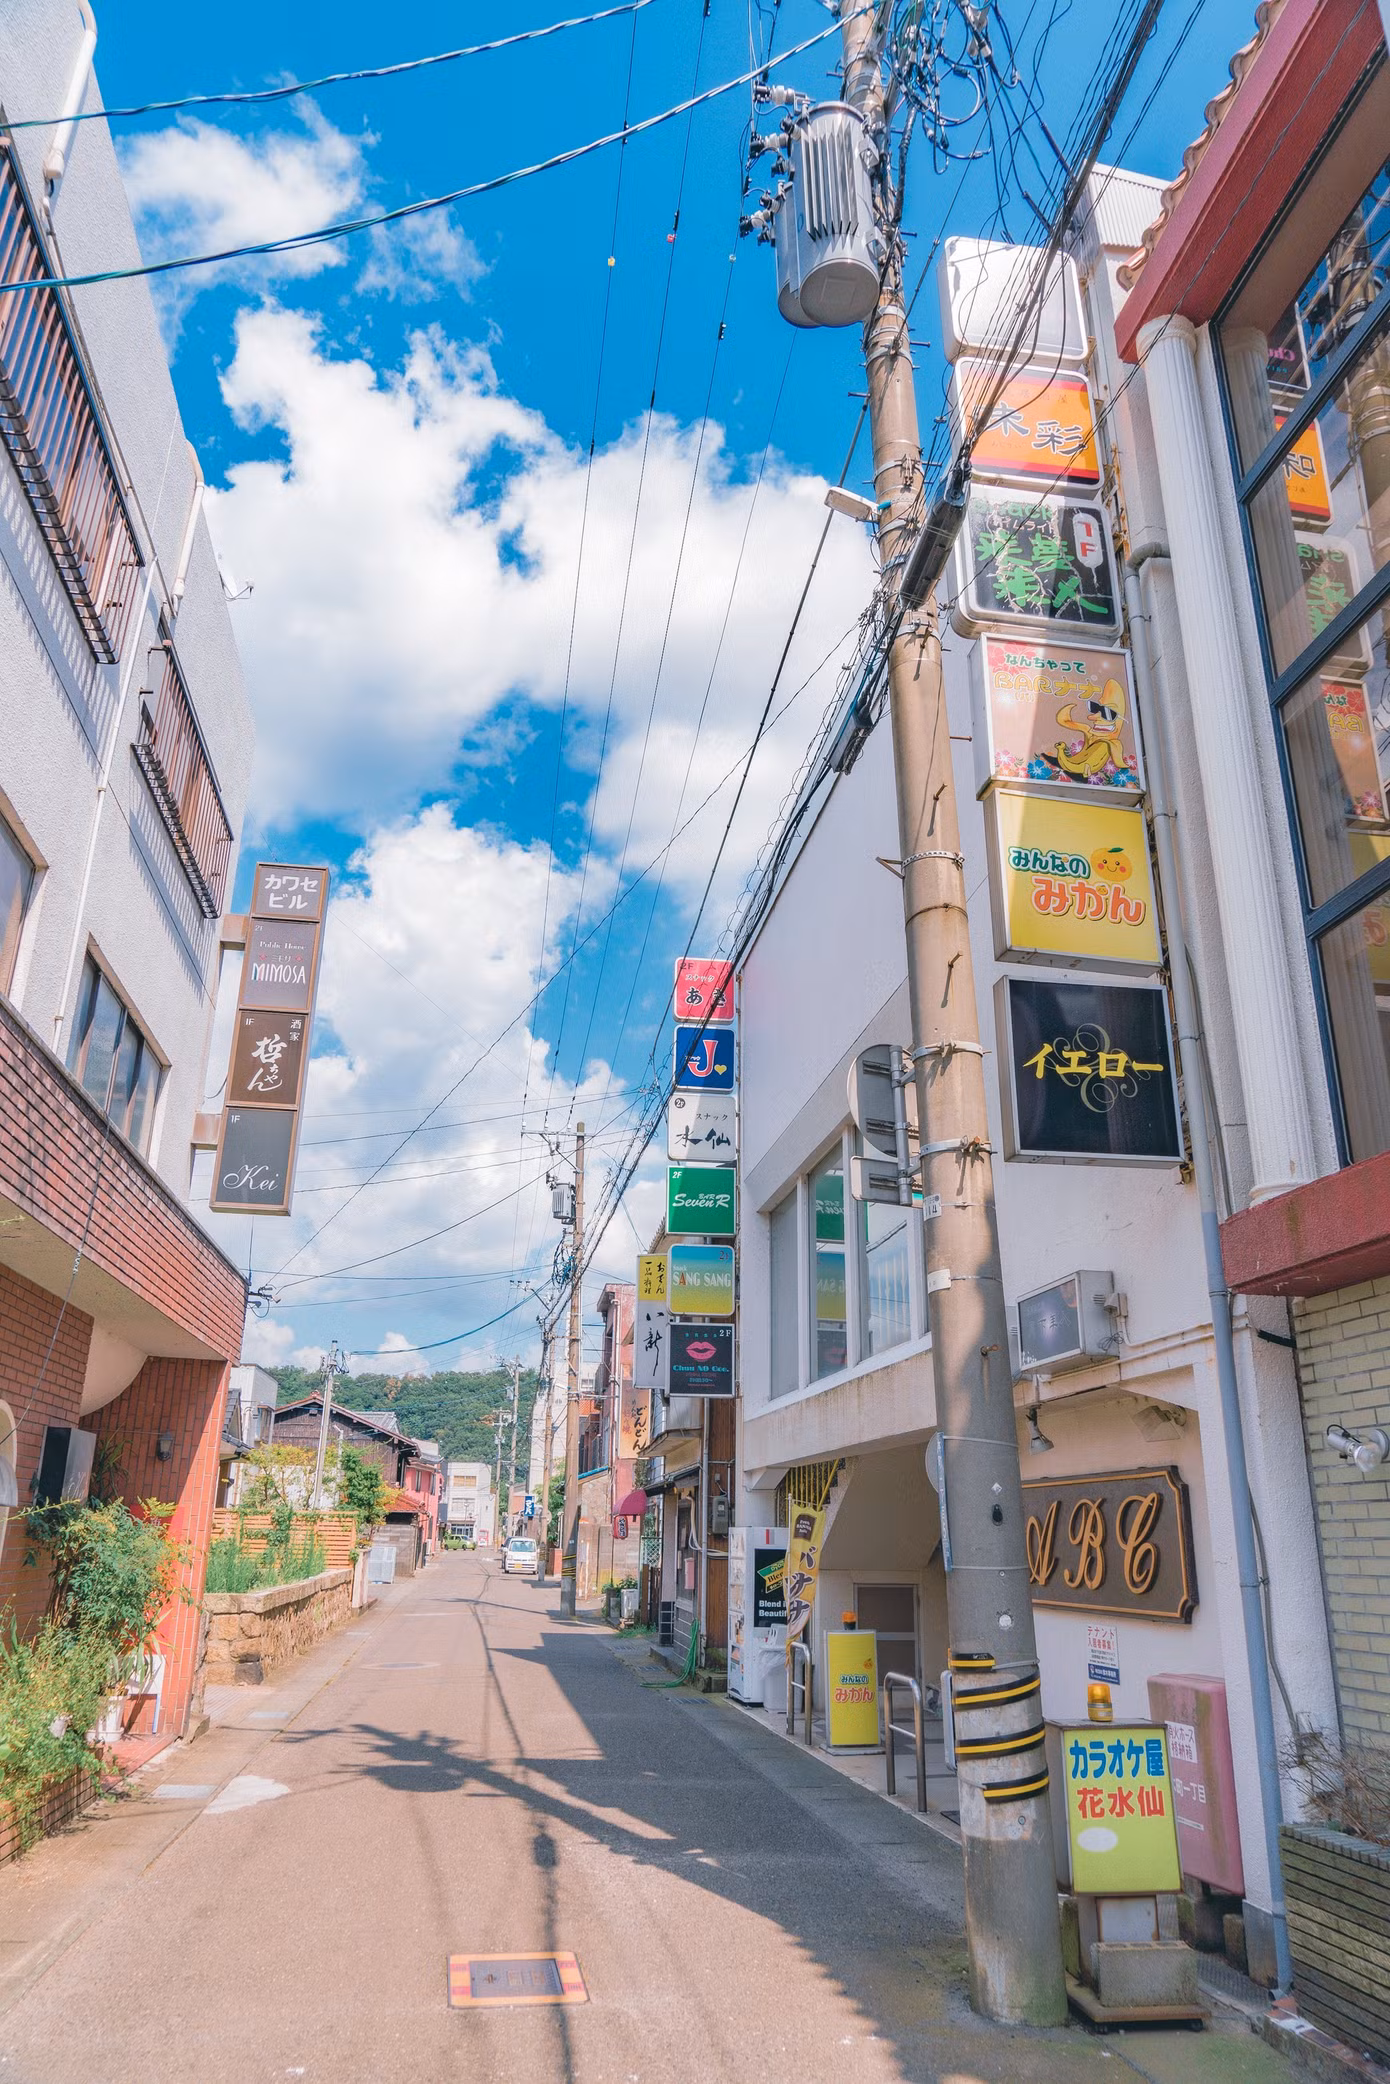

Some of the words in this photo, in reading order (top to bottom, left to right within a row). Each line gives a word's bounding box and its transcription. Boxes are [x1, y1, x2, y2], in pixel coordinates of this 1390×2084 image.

[1004, 652, 1086, 674] なんちゃって
[1008, 847, 1091, 878] みんなの
[264, 874, 318, 893] カワセ
[268, 892, 308, 910] ビル
[1031, 876, 1146, 926] みかん
[251, 963, 307, 985] MIMOSA
[680, 962, 694, 970] 2F
[687, 1039, 719, 1077] J
[1022, 1043, 1164, 1079] イエロー
[696, 1113, 728, 1121] スナック
[672, 1171, 682, 1179] 2F
[672, 1193, 715, 1208] Seven
[698, 1193, 715, 1201] BAR
[672, 1271, 700, 1287] SANG
[703, 1273, 731, 1288] SANG
[719, 1329, 732, 1337] 2F
[1088, 1626, 1114, 1639] テナント
[839, 1674, 869, 1685] みんなの
[834, 1687, 874, 1703] みかん
[1070, 1739, 1165, 1779] カラオケ屋
[1077, 1785, 1165, 1819] 花水仙
